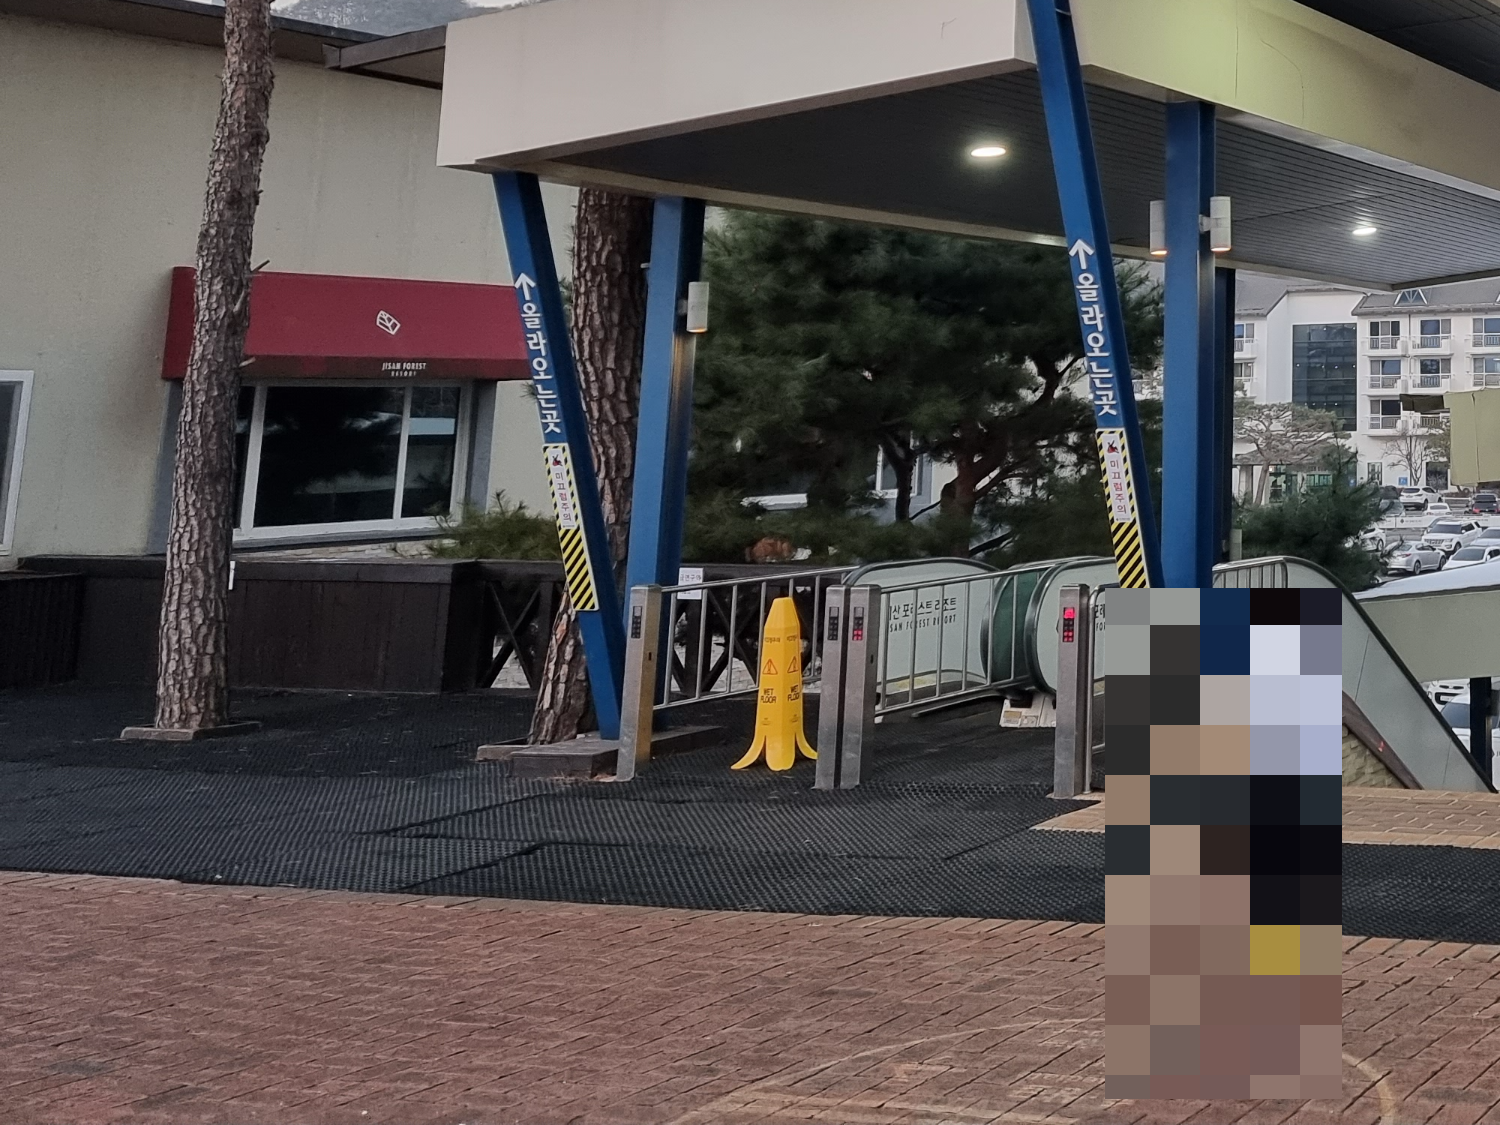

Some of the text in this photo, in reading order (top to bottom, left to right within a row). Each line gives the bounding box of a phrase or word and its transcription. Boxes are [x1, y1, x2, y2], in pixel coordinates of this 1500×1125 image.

[382, 362, 427, 371] JISAN FOREST
[933, 614, 956, 626] REORT
